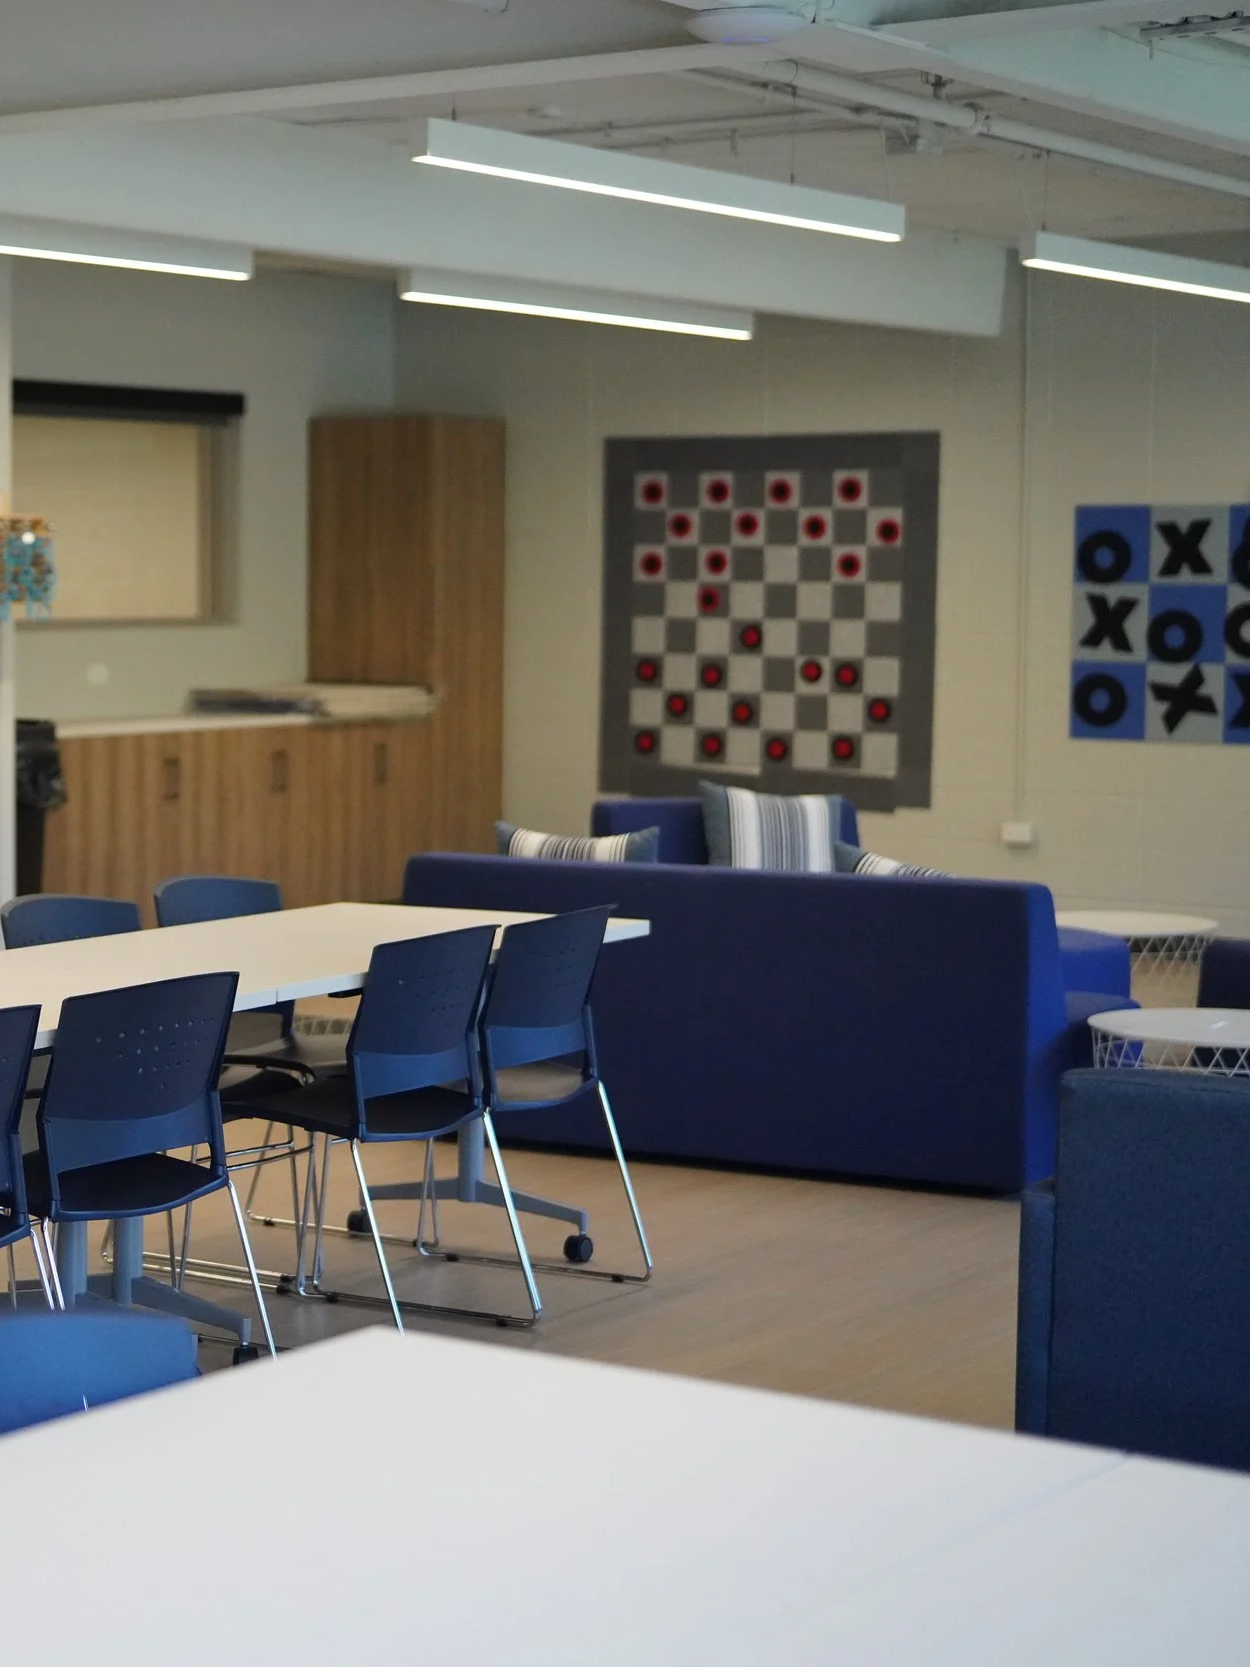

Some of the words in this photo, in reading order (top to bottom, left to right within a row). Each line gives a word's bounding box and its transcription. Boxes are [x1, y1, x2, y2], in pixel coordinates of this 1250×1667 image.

[1077, 530, 1131, 584] O
[1155, 518, 1213, 577] X
[1079, 592, 1139, 654] X
[1148, 609, 1202, 663] O
[1073, 673, 1126, 727] O
